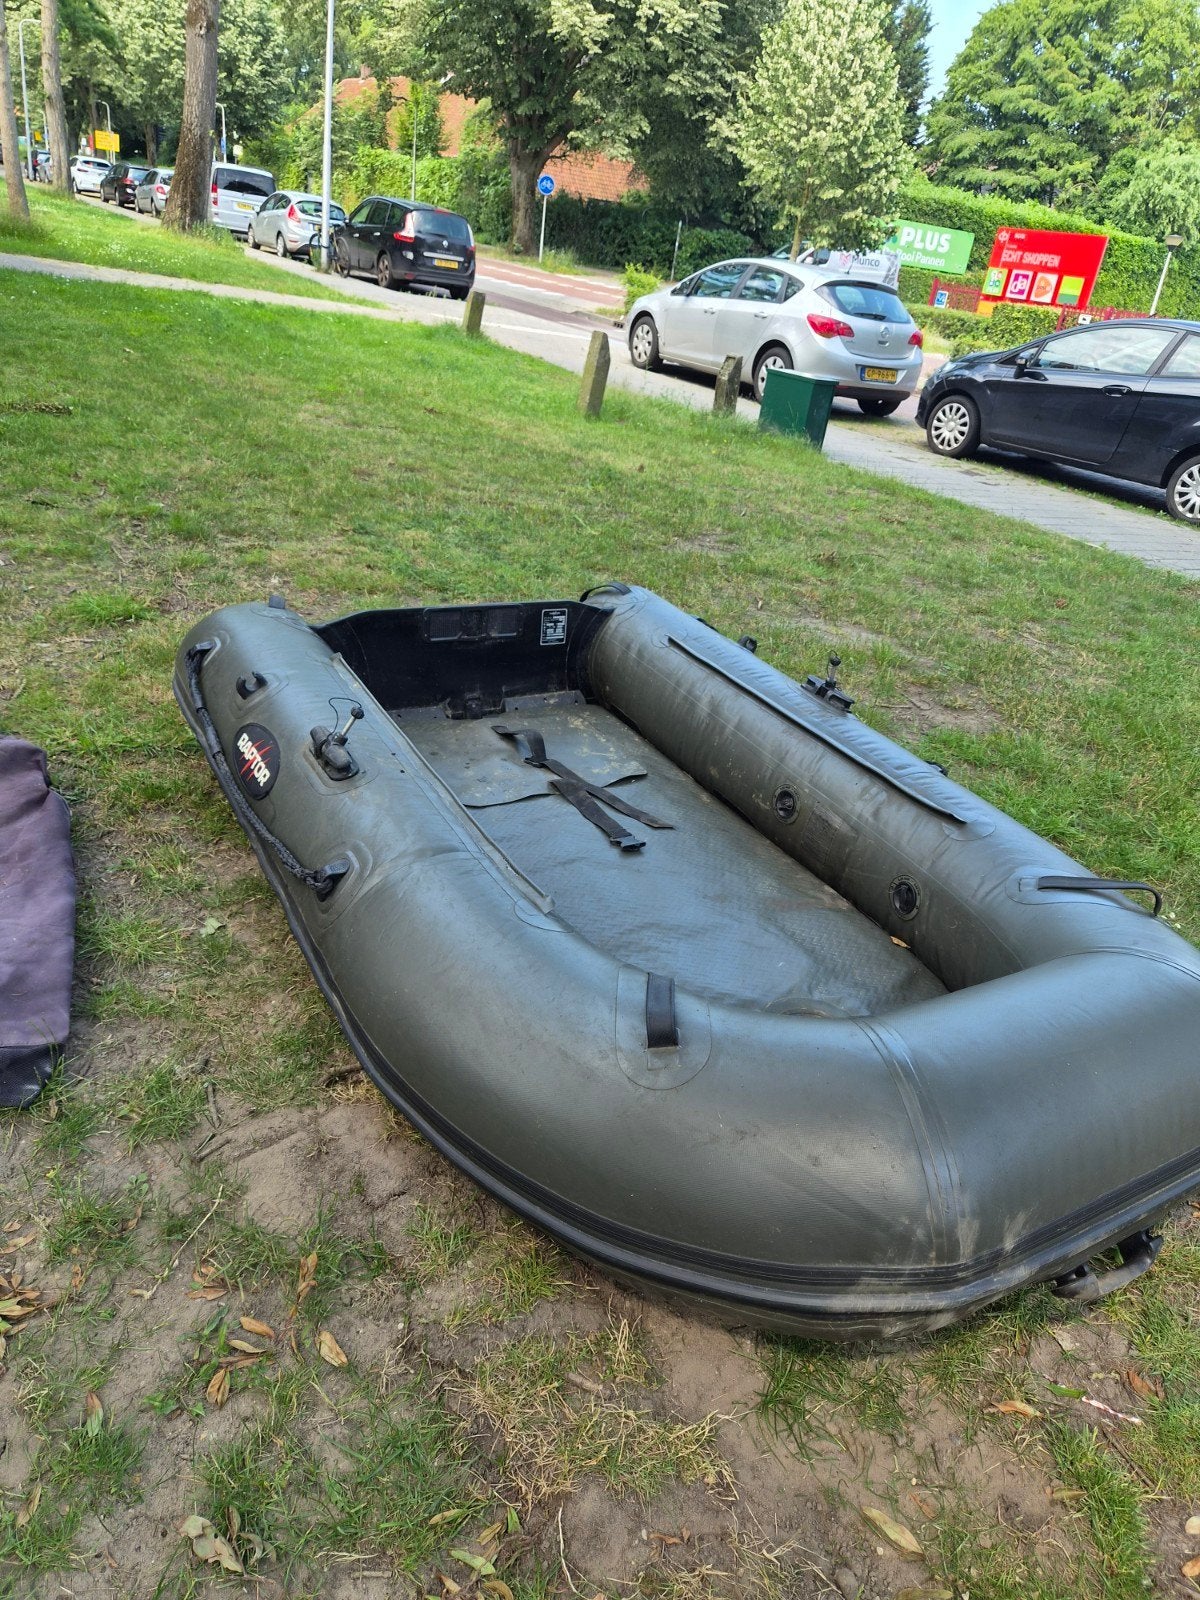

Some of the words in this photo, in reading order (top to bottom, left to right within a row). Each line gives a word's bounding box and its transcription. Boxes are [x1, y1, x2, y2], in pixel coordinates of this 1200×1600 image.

[900, 226, 951, 254] PLUS
[914, 251, 945, 267] Pannen
[1001, 249, 1023, 263] ECHT
[1022, 251, 1061, 268] SHOPPEN
[237, 733, 271, 787] RAPTOR
